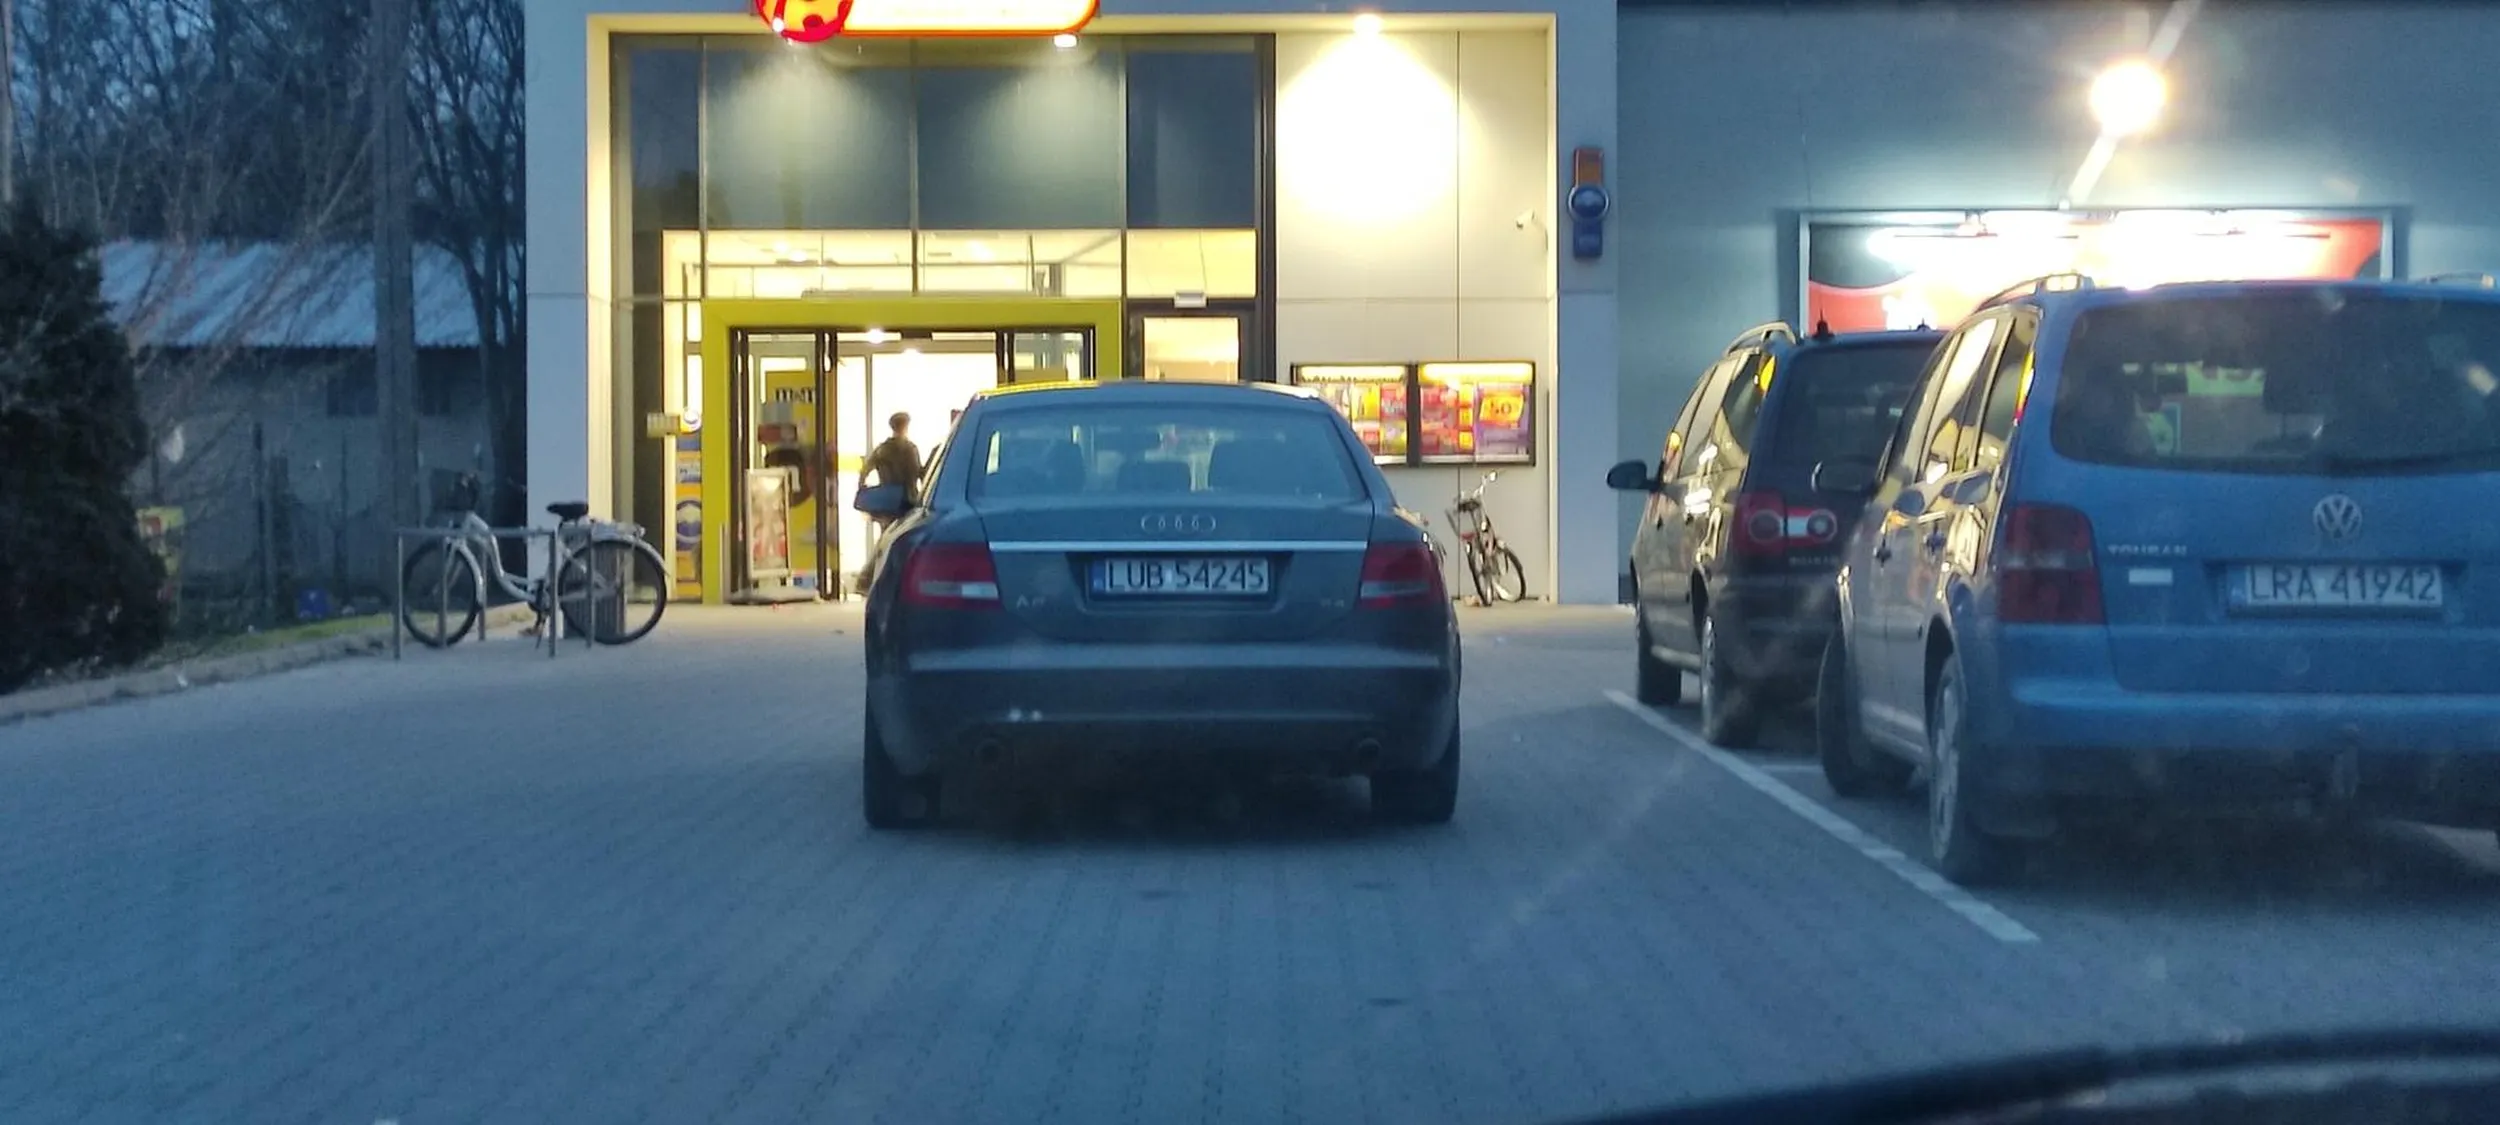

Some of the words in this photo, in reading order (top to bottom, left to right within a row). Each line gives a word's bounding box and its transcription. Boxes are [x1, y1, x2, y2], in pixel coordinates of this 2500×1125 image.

[1108, 561, 1164, 589] LUB
[1174, 561, 1265, 589] 54245
[2251, 565, 2318, 600] LRA
[2329, 565, 2437, 600] 41942
